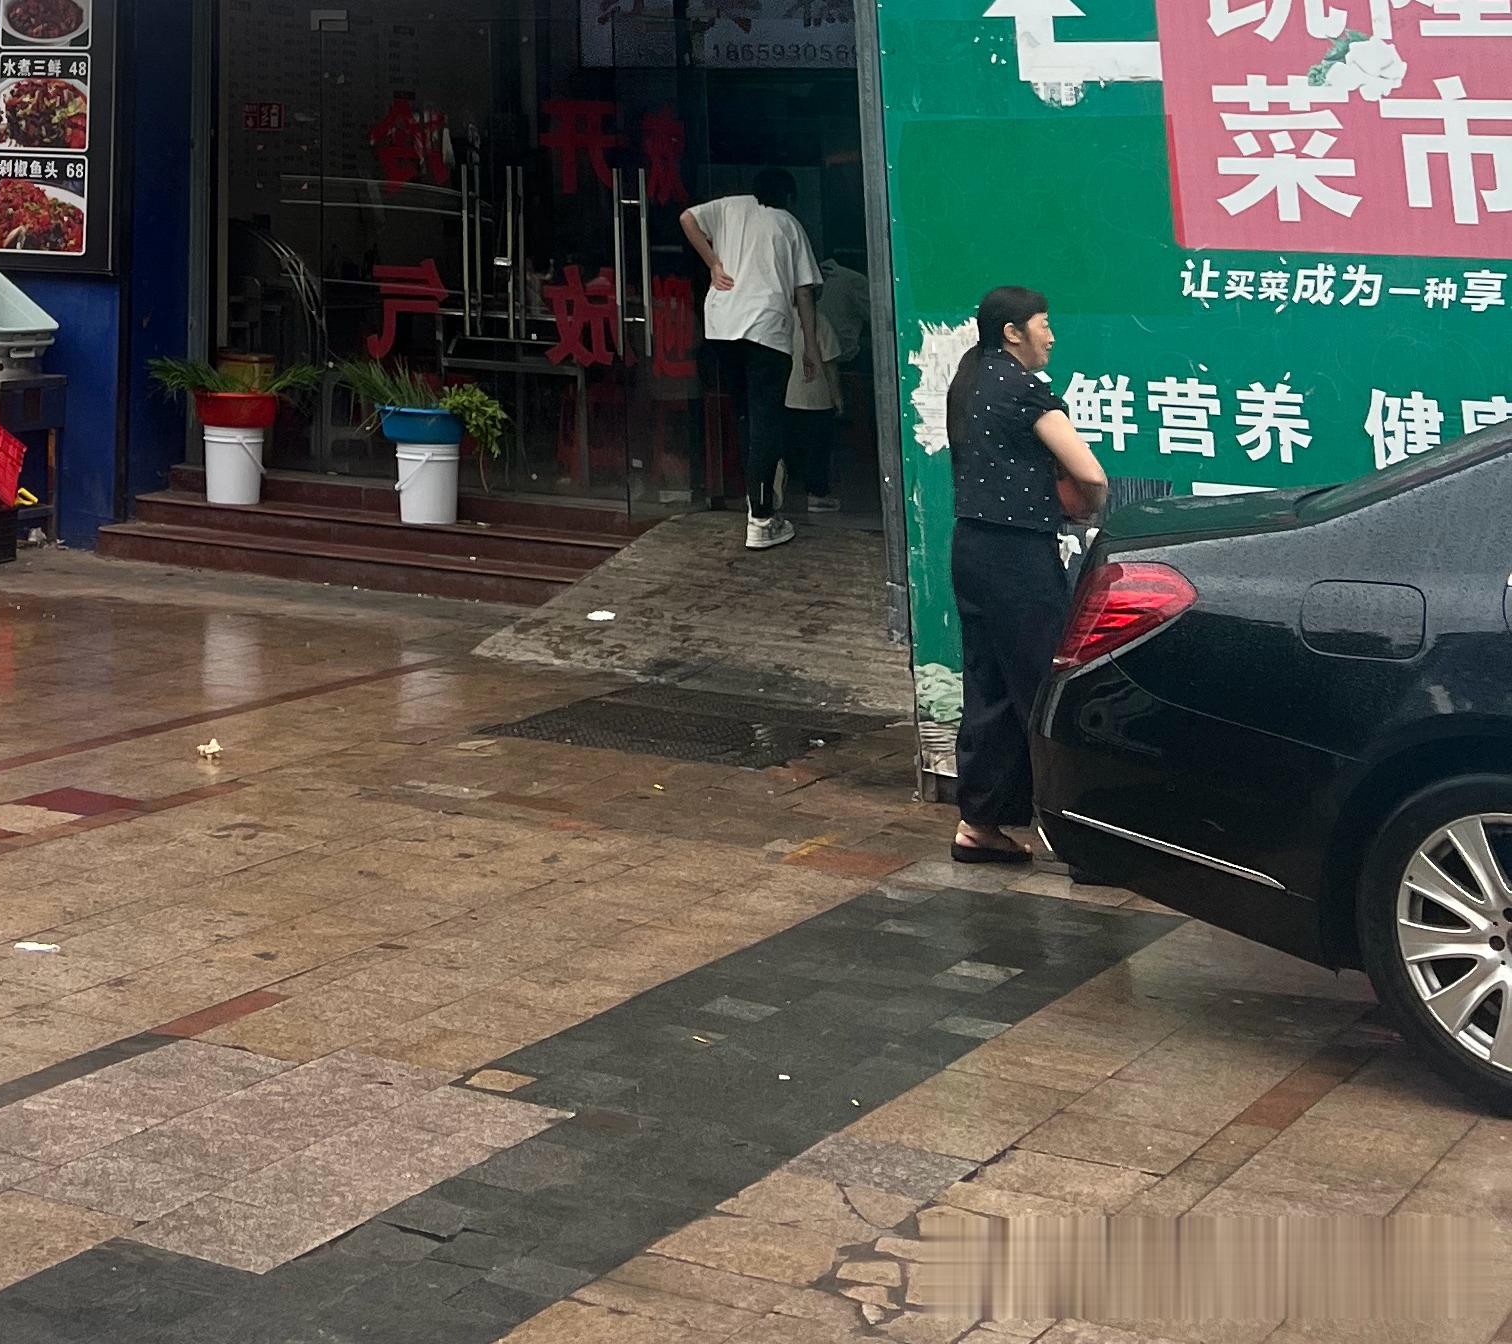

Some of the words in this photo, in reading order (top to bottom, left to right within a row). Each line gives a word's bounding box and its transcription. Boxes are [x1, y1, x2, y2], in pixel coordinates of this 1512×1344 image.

[3, 59, 62, 76] 水煮三鲜
[69, 61, 87, 76] 48
[67, 163, 84, 178] 68
[1211, 74, 1512, 225] 菜市
[1181, 258, 1512, 312] 让买菜成为一种享
[1037, 369, 1312, 464] 鲜营养
